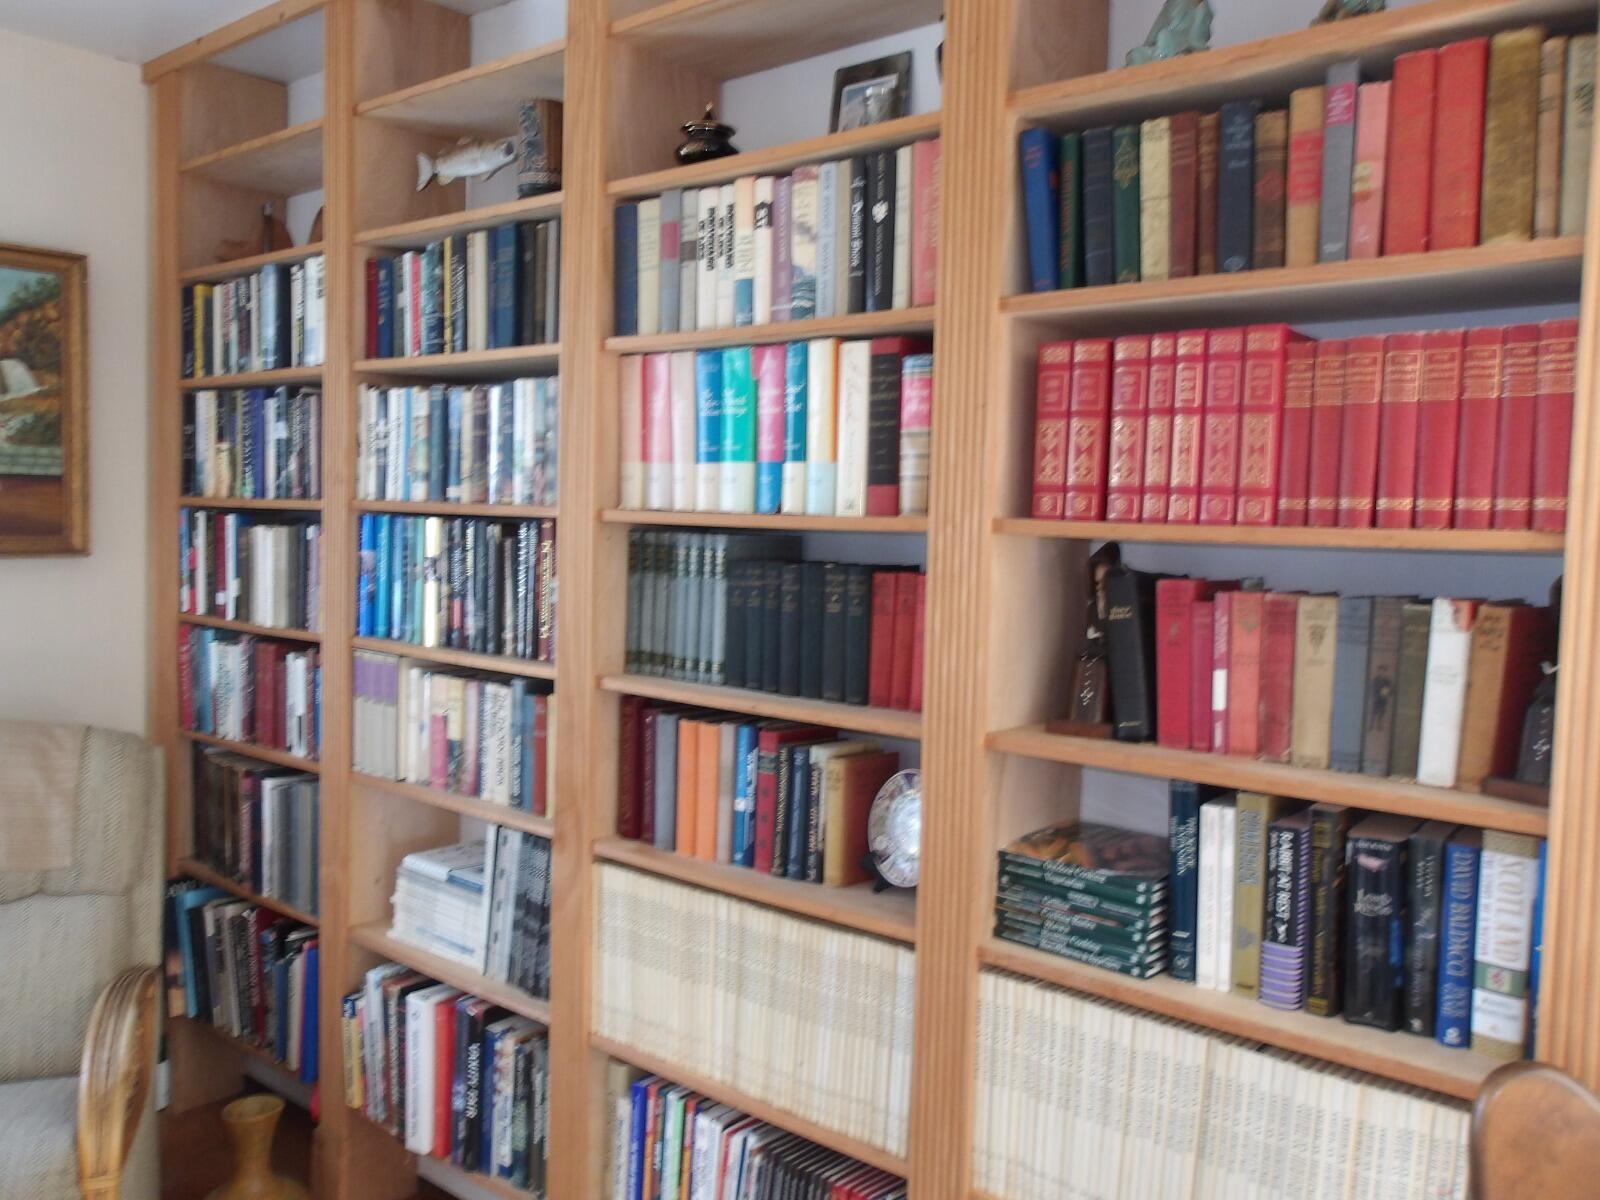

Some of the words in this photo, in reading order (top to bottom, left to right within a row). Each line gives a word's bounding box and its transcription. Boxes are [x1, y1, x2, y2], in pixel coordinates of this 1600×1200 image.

[1279, 831, 1294, 873] RABBIT
[1277, 872, 1292, 891] AT
[1451, 852, 1474, 900] DAVID
[1276, 891, 1292, 921] REST
[1494, 859, 1526, 964] SCOTLAND
[1446, 903, 1473, 977] BALDACCI
